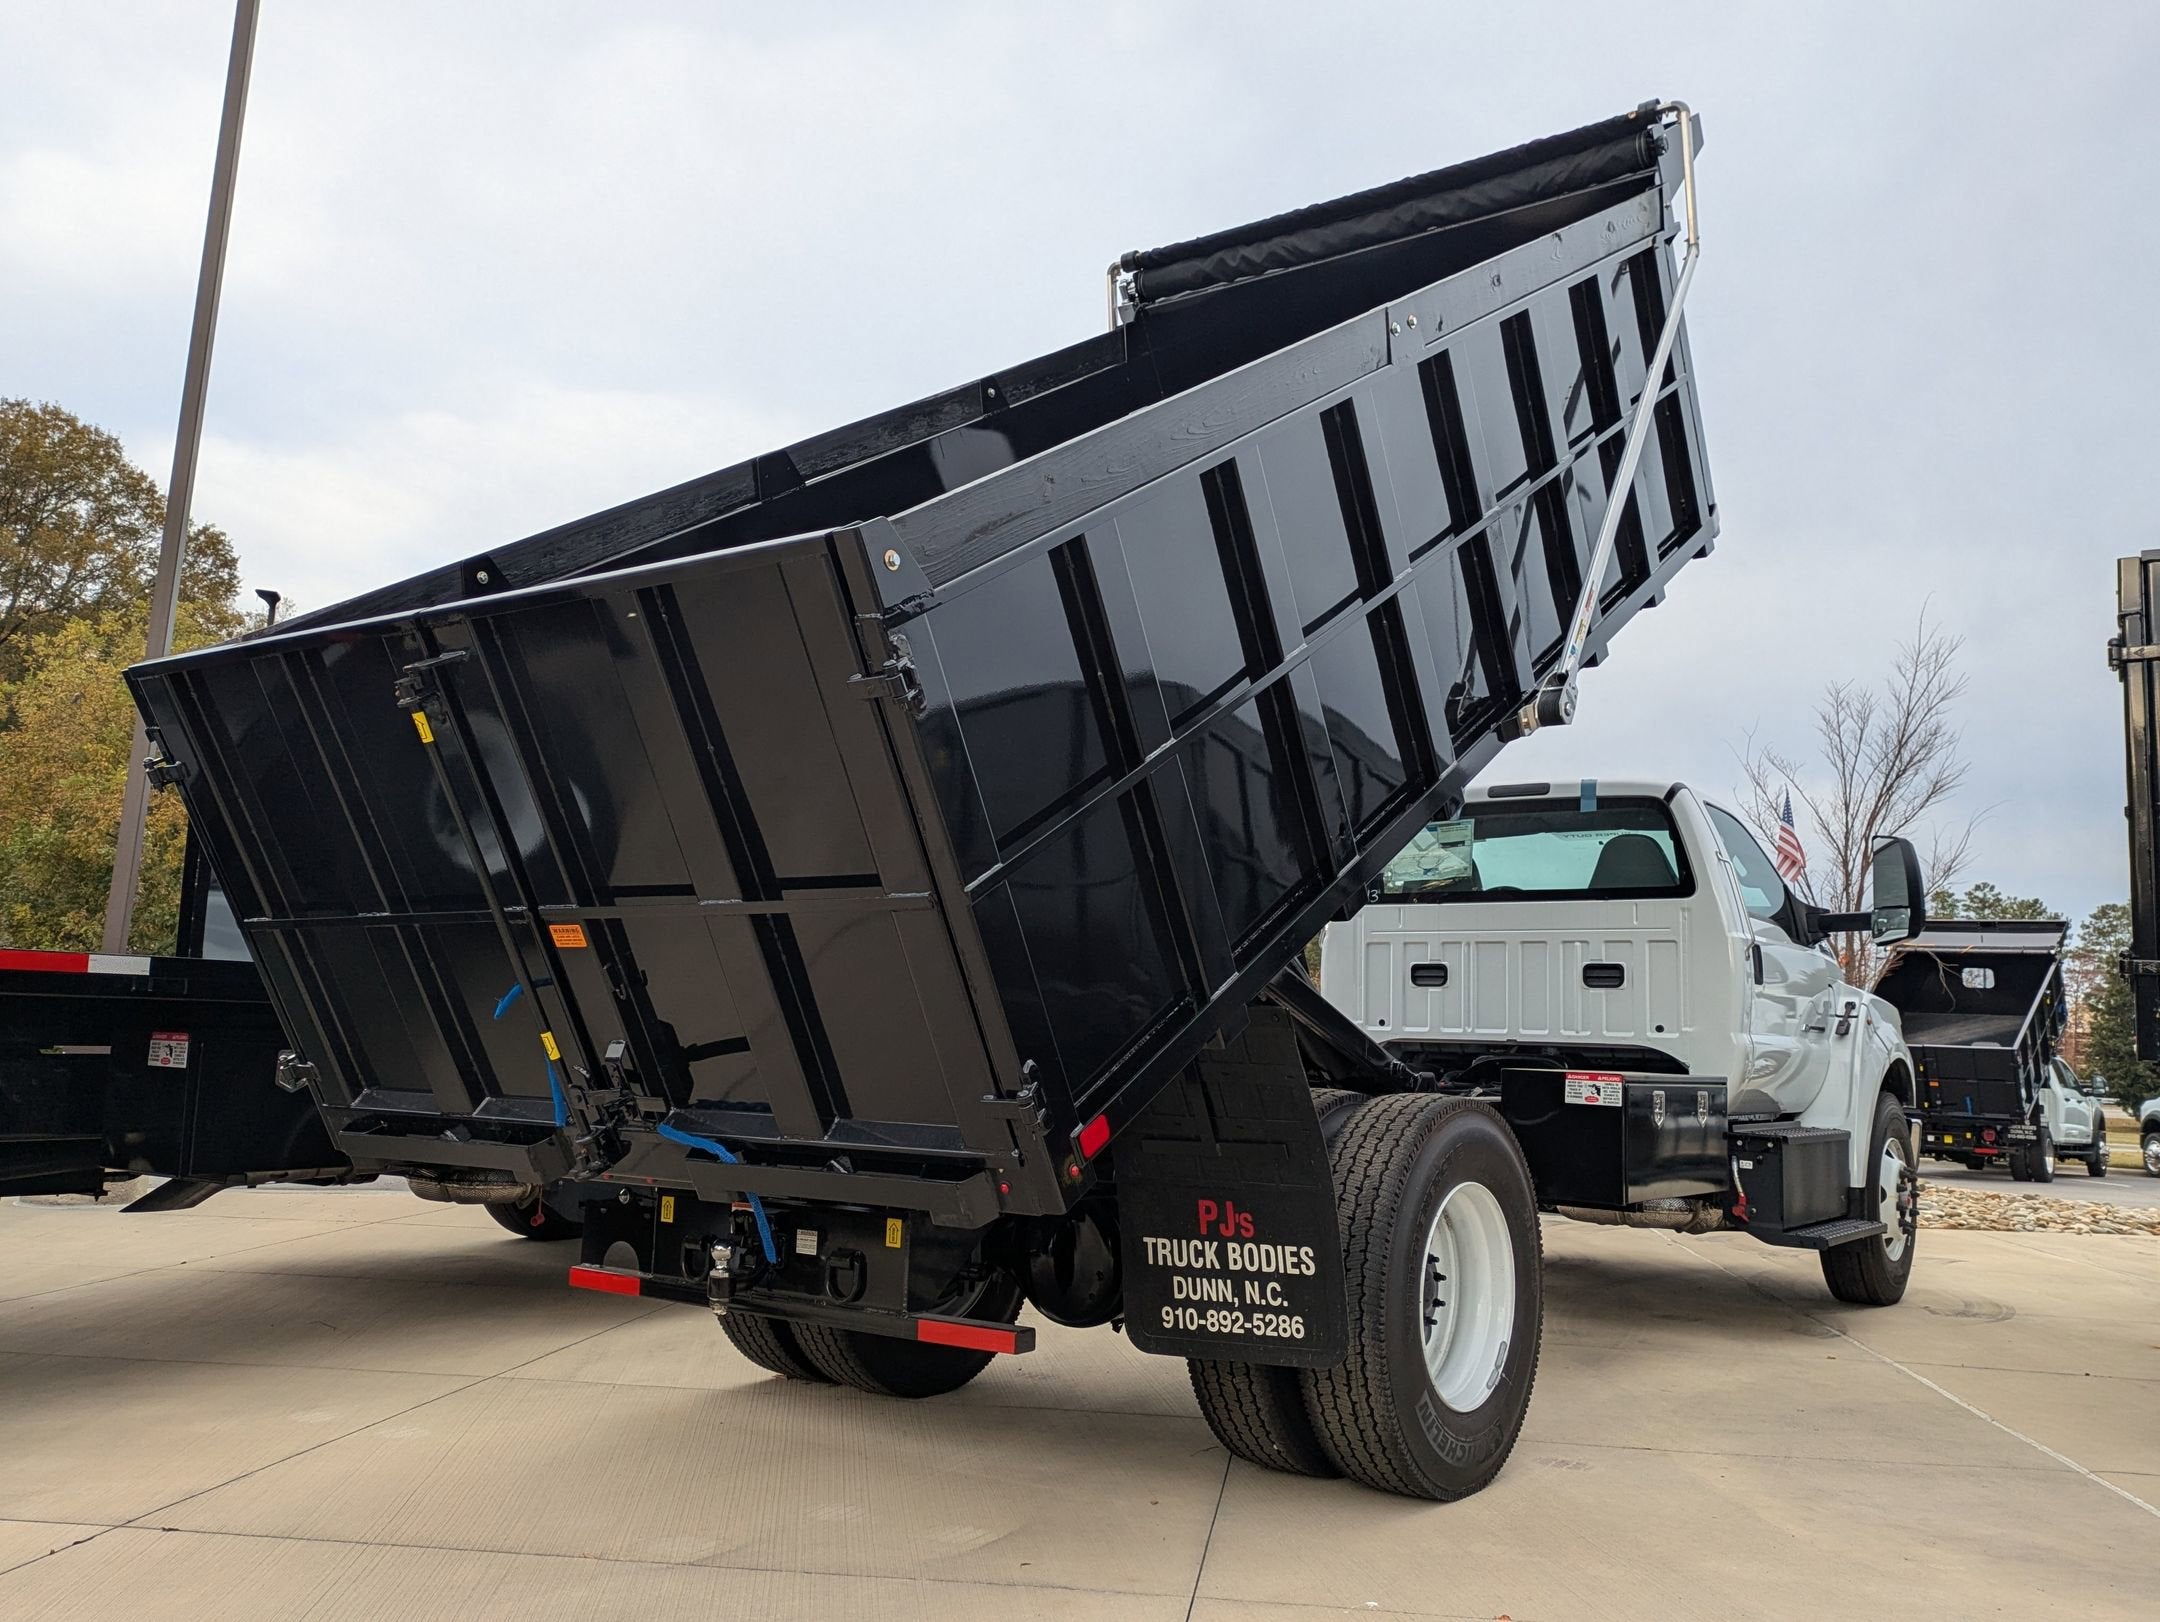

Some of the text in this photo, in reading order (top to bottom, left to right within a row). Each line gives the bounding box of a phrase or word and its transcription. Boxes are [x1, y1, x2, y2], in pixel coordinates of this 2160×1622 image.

[1197, 1199, 1256, 1239] PJ's
[1142, 1236, 1317, 1276] TRUCK BODIES
[1172, 1276, 1289, 1308] DUNN, N.C.
[1161, 1306, 1305, 1339] 910-892-5286
